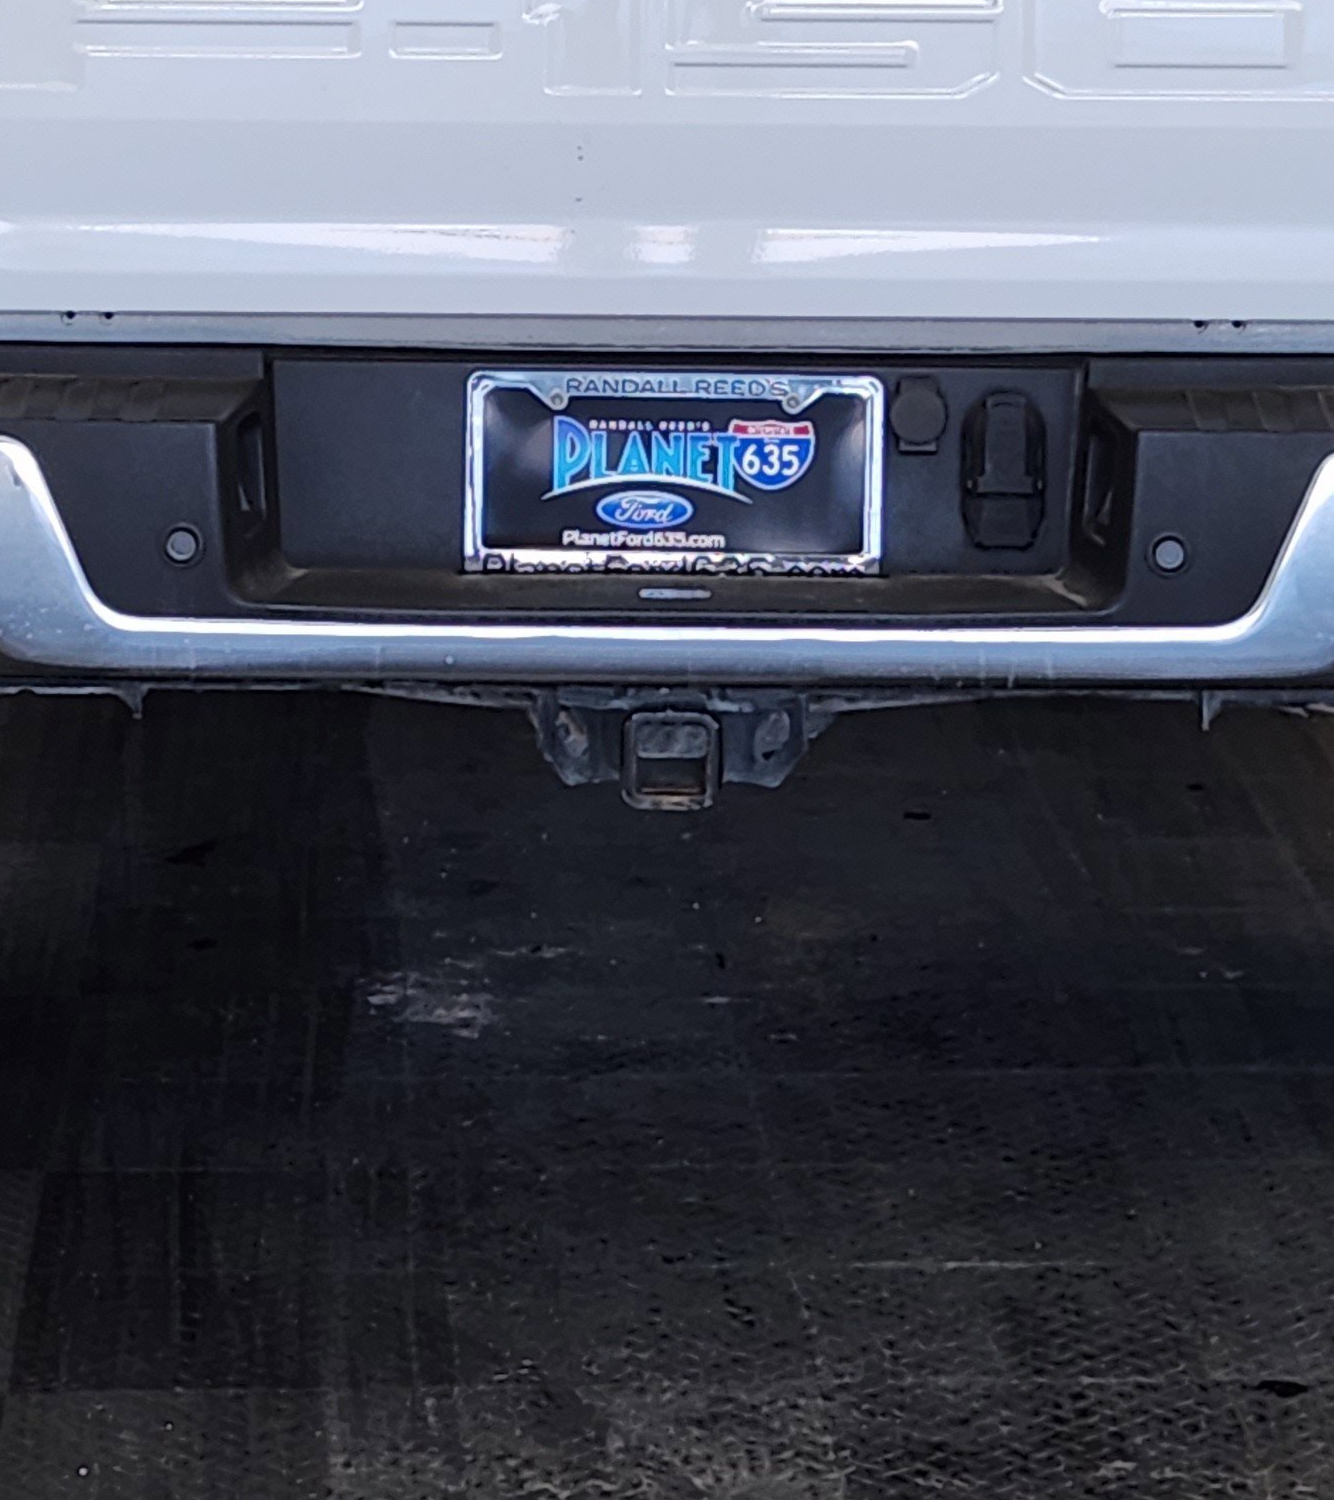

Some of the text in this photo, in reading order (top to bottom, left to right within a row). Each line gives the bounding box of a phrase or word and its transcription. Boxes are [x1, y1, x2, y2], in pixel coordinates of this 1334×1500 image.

[566, 377, 789, 397] RANDALL REED'S
[553, 415, 800, 493] PLANET 635
[614, 494, 674, 523] Ford
[561, 529, 727, 549] PlanetFord635.com
